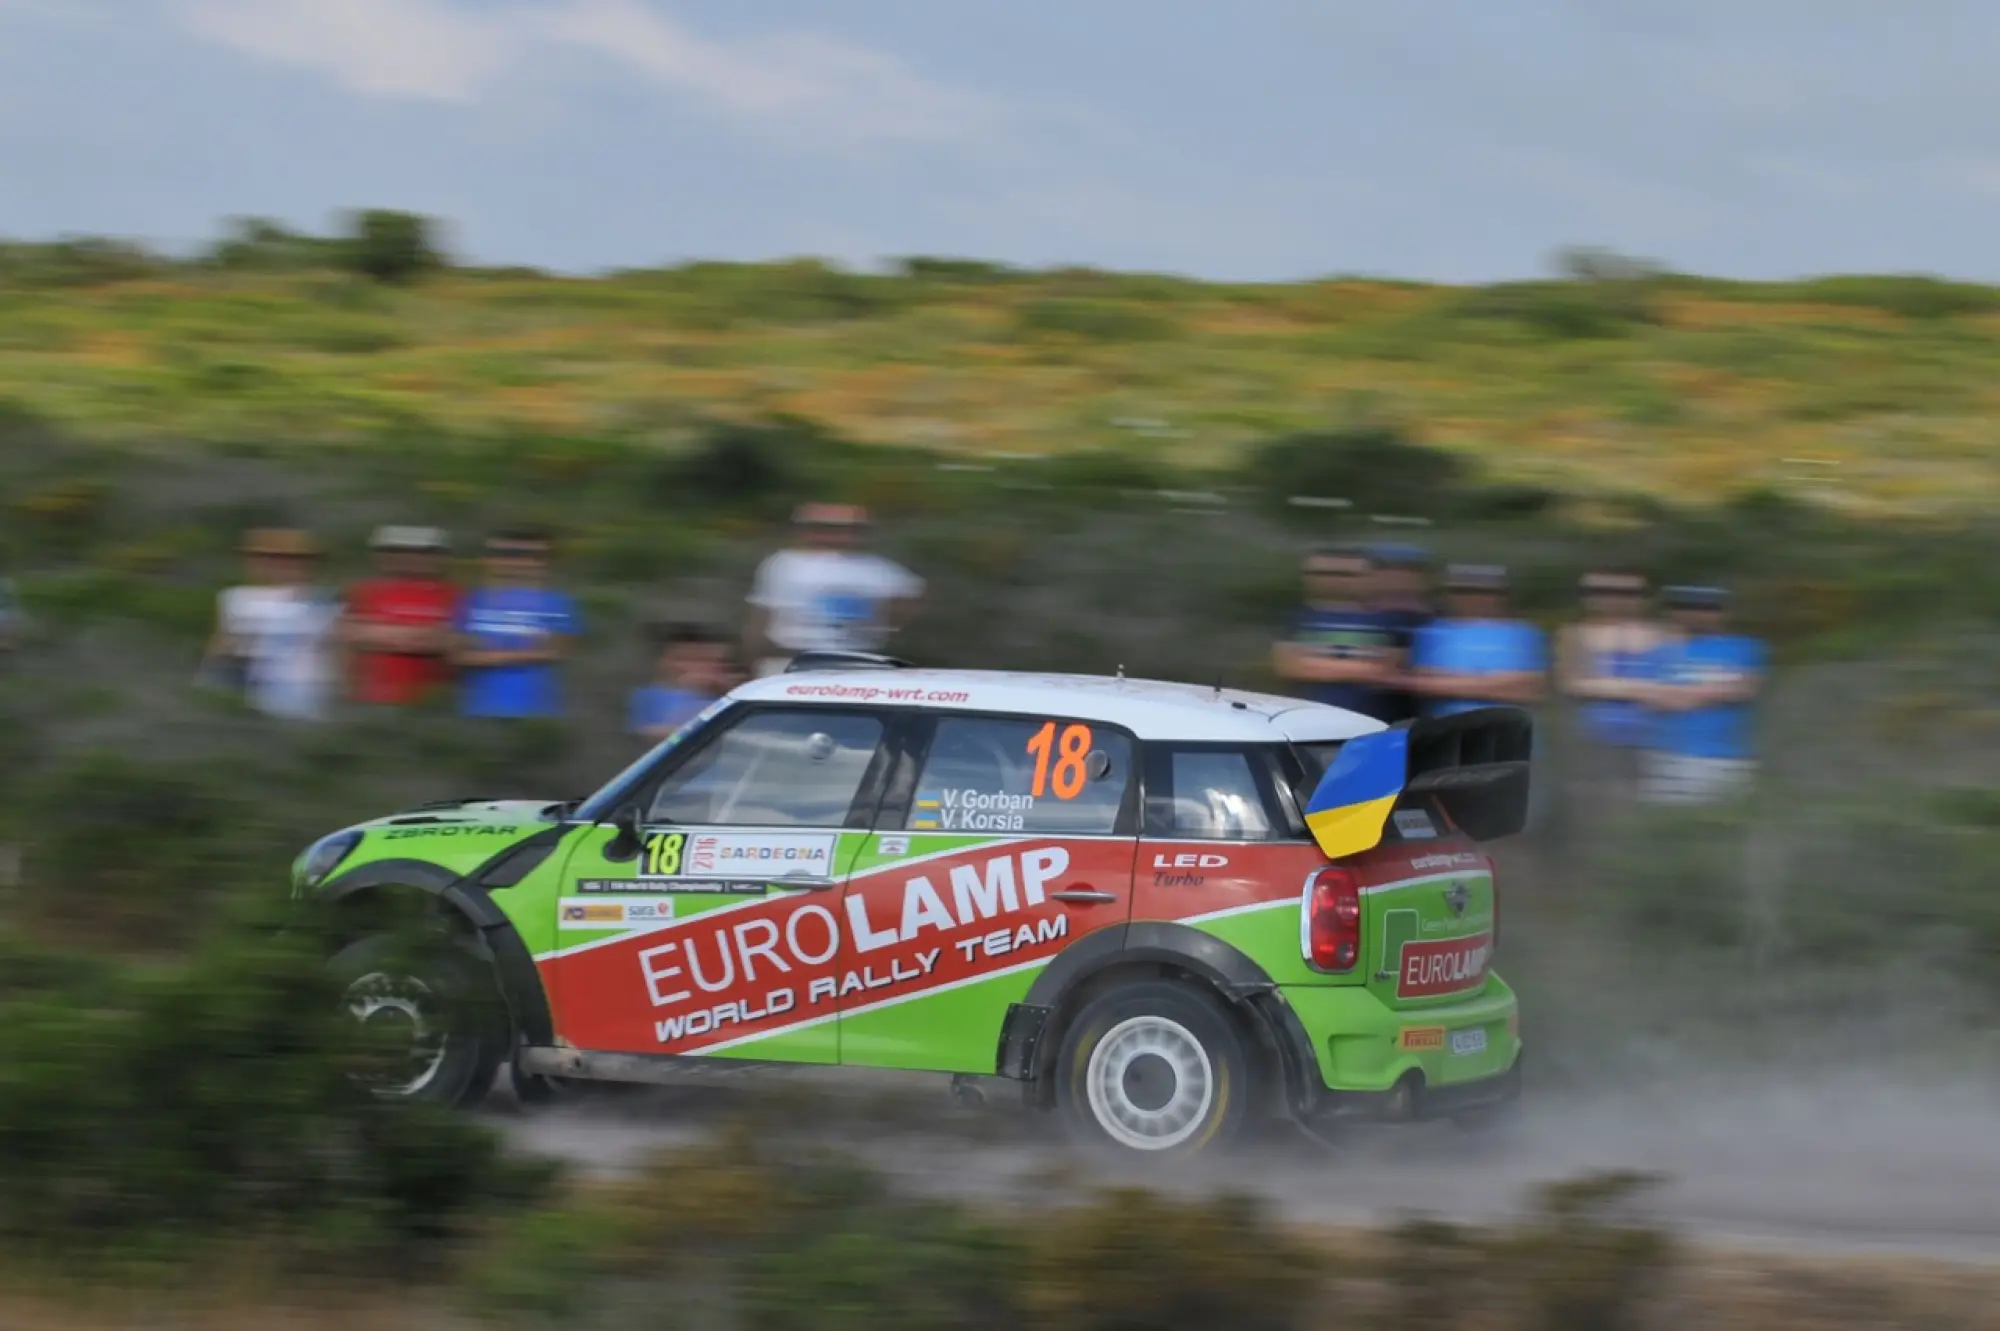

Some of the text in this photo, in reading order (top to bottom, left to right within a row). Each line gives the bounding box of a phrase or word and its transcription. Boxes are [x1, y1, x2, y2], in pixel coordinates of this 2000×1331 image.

[786, 684, 970, 701] eurolamp-wrt.com
[1027, 721, 1092, 799] 18
[962, 789, 1034, 810] Gorban
[940, 808, 1024, 830] V. Korsia
[645, 833, 682, 875] 18
[719, 846, 826, 860] SARDEGNA
[1153, 853, 1229, 868] LED
[1153, 871, 1205, 887] Turbo
[638, 845, 1070, 1007] EUROLAMP
[654, 914, 1069, 1043] WORLD RALLY TEAM
